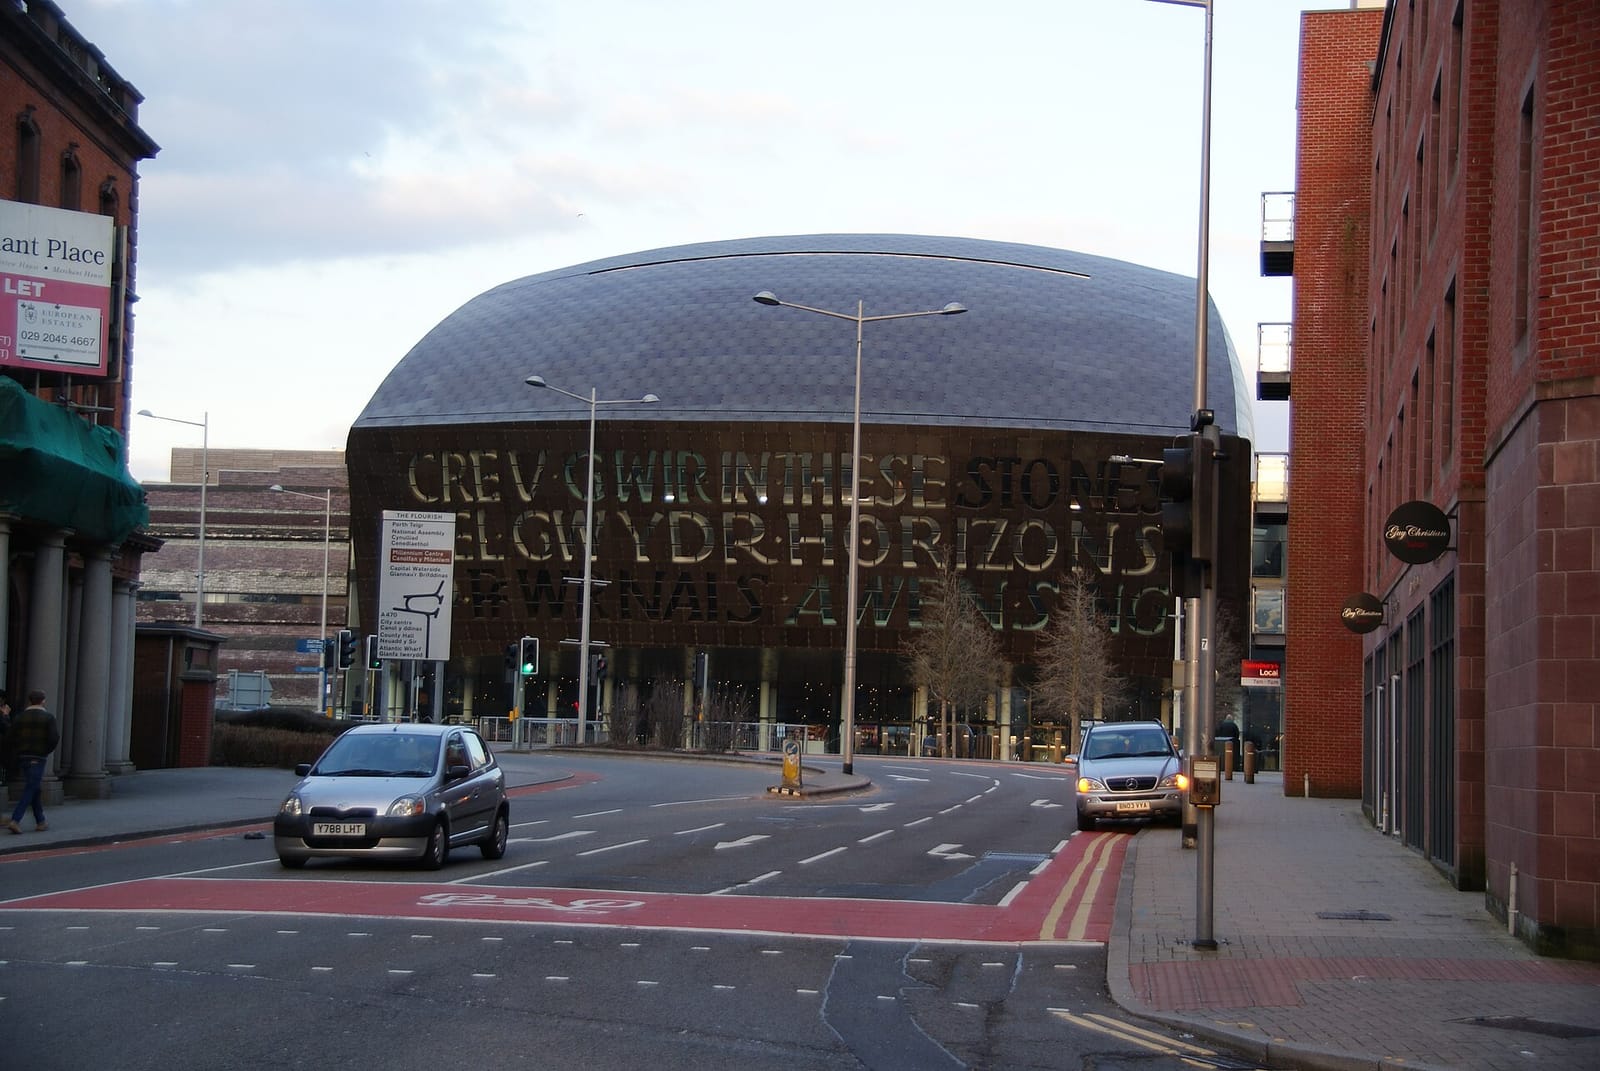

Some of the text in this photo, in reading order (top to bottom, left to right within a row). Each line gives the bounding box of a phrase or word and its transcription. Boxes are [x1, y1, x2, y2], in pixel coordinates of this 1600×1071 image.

[0, 236, 105, 266] ant Place
[4, 277, 46, 298] LET
[42, 308, 93, 322] EUROPEAN
[42, 318, 84, 330] ESTATES
[21, 330, 96, 347] 029 2045 4667
[562, 449, 713, 504] GWIR
[774, 452, 947, 509] THESE
[1386, 524, 1448, 540] Guy Christian
[511, 508, 779, 566] GWYDR
[786, 512, 1165, 577] HORIZONS
[1012, 581, 1170, 638] SNG
[1260, 668, 1278, 676] Local
[318, 824, 362, 834] Y788 LHT
